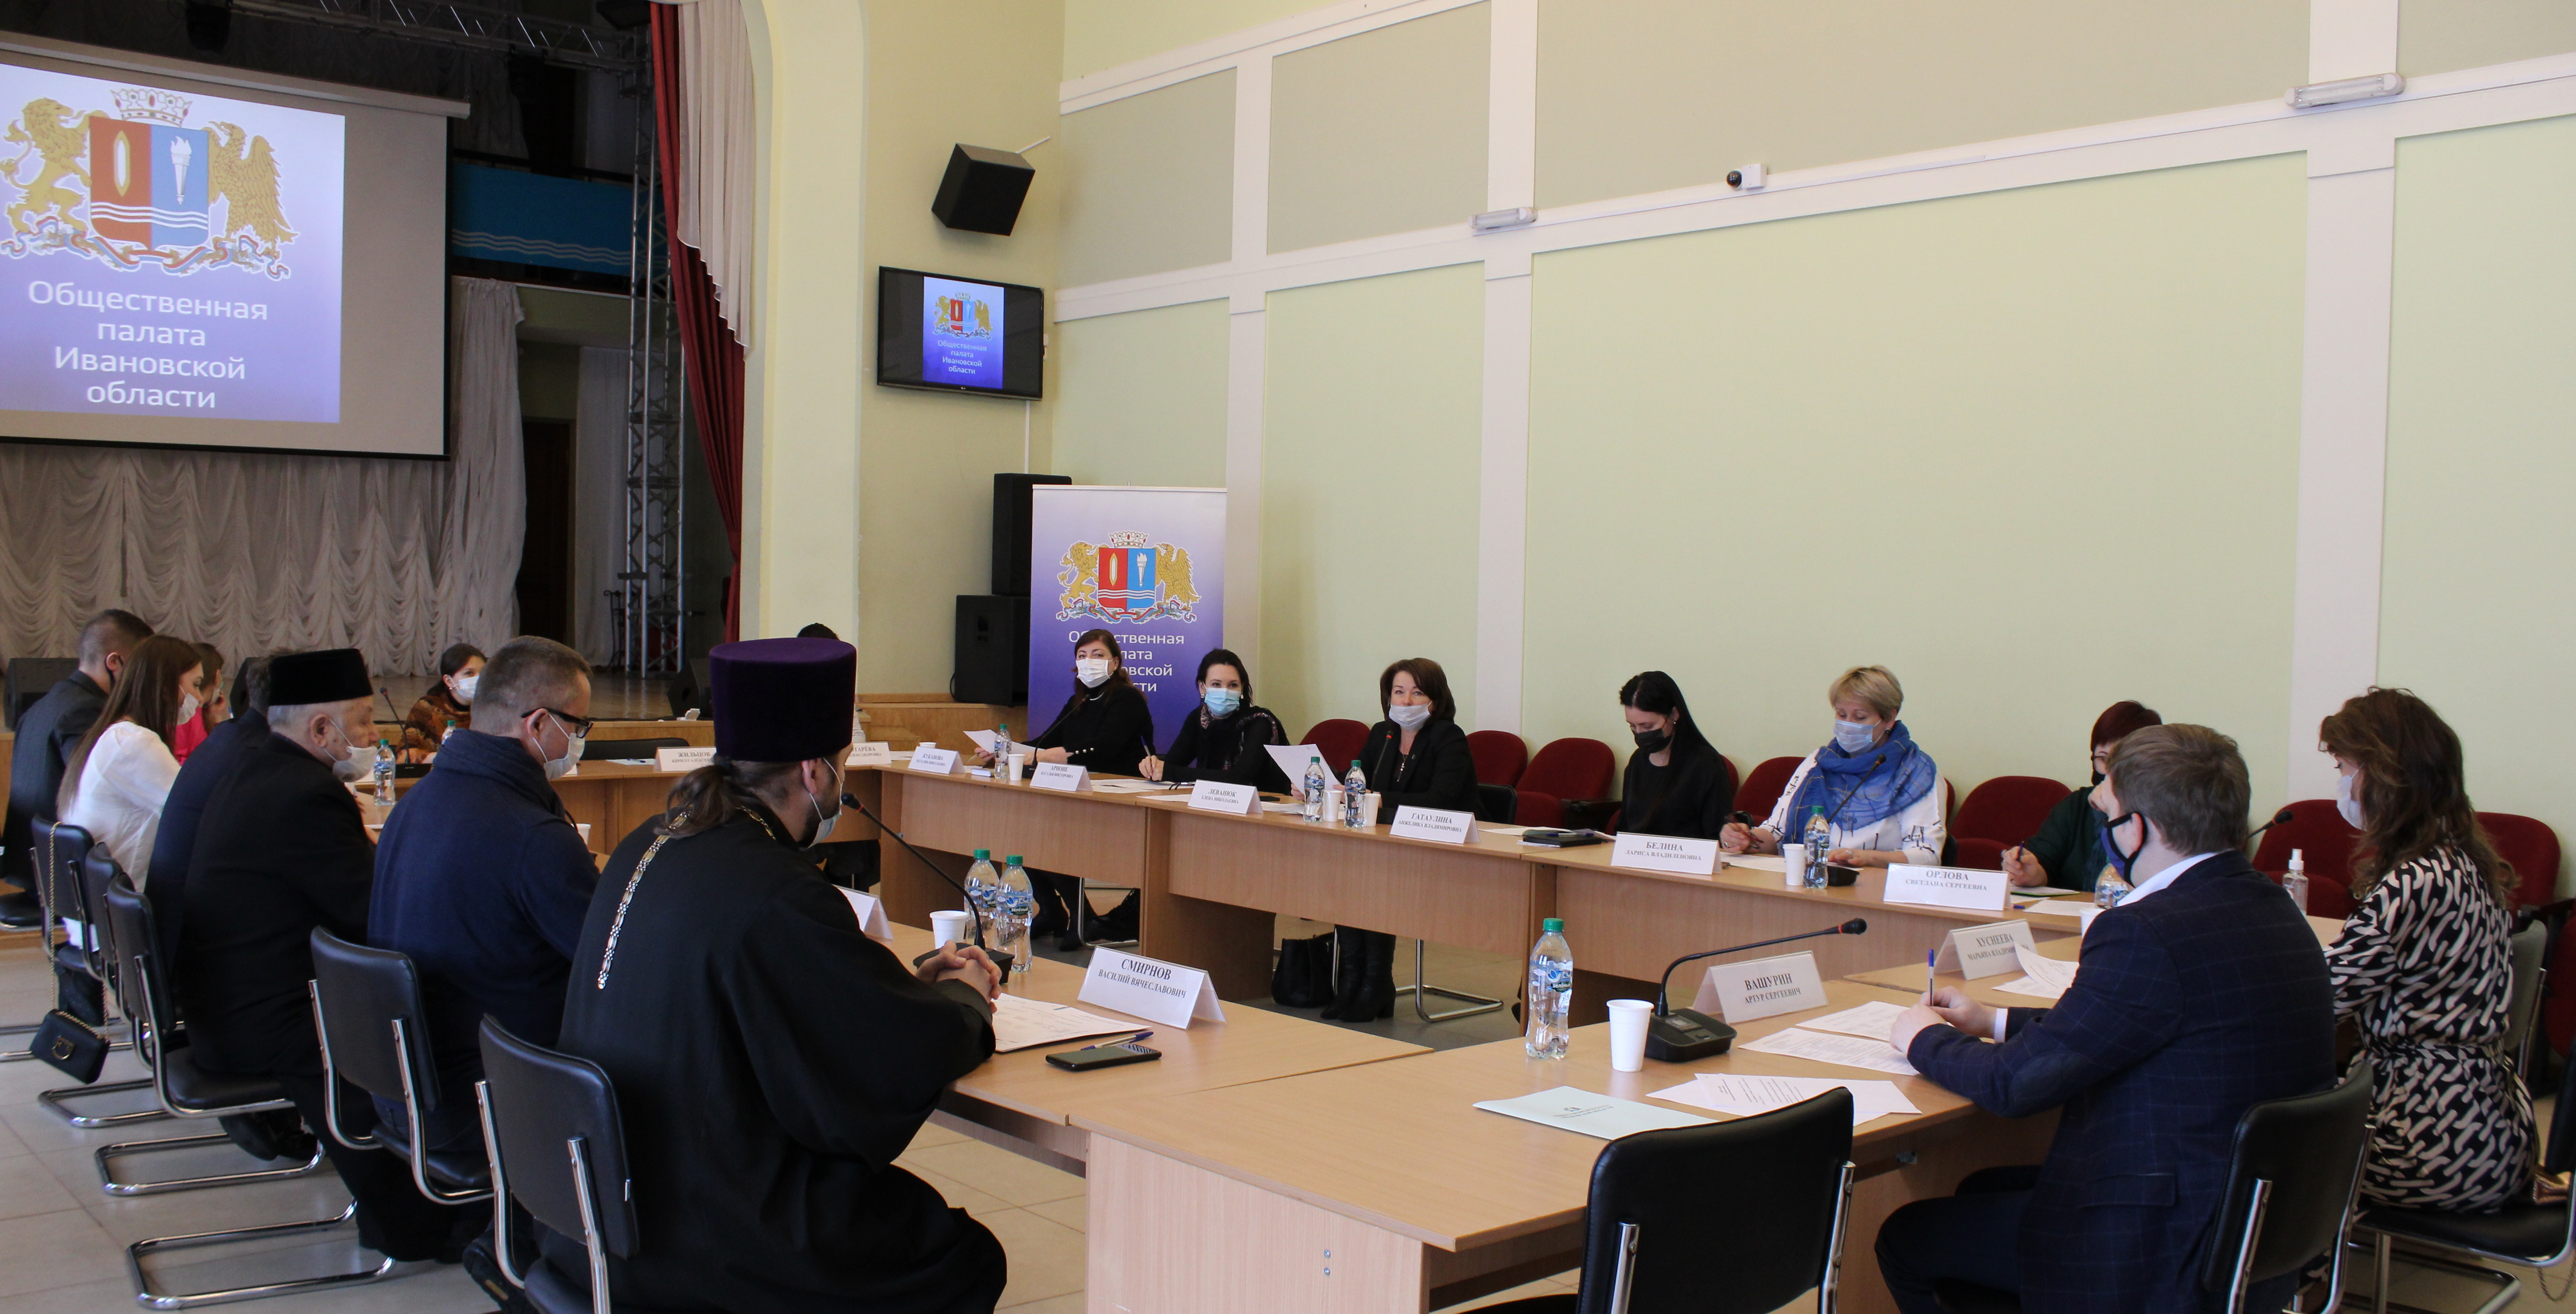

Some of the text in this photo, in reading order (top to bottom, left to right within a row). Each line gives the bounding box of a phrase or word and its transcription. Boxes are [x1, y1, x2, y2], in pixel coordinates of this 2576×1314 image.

[29, 281, 267, 320] Общественная
[98, 323, 206, 346] палата
[938, 340, 987, 351] Общественная
[55, 346, 245, 379] Ивановской
[942, 356, 982, 367] Ивановской
[948, 365, 976, 374] области
[87, 380, 215, 408] области
[1069, 630, 1185, 644] Оственная
[1121, 650, 1153, 660] лата
[1208, 788, 1237, 797] ЛЕВАНЮК
[1411, 813, 1452, 824] ГАТАУЛИНА
[1424, 824, 1462, 832] ВЛАДИМИРОВНА
[1646, 842, 1683, 851] БЕЛИНА
[1651, 852, 1701, 861] ВЛАДИЛЕНОВНА
[1926, 870, 1969, 880] ОРЛОВА
[1905, 879, 1987, 891] СВЕТЛАНА СЕРГЕЕВНА
[1976, 933, 2014, 947] ХУСНЕЕВА
[1121, 958, 1171, 980] СМИРНОВ
[1098, 969, 1187, 998] ВАСИЛИЙ ВЯЧЕСЛАВОВИЧ
[1744, 973, 1792, 990] ВАШУРИН
[1745, 987, 1801, 1004] АРТУР СЕРГЕЕВИЧ
